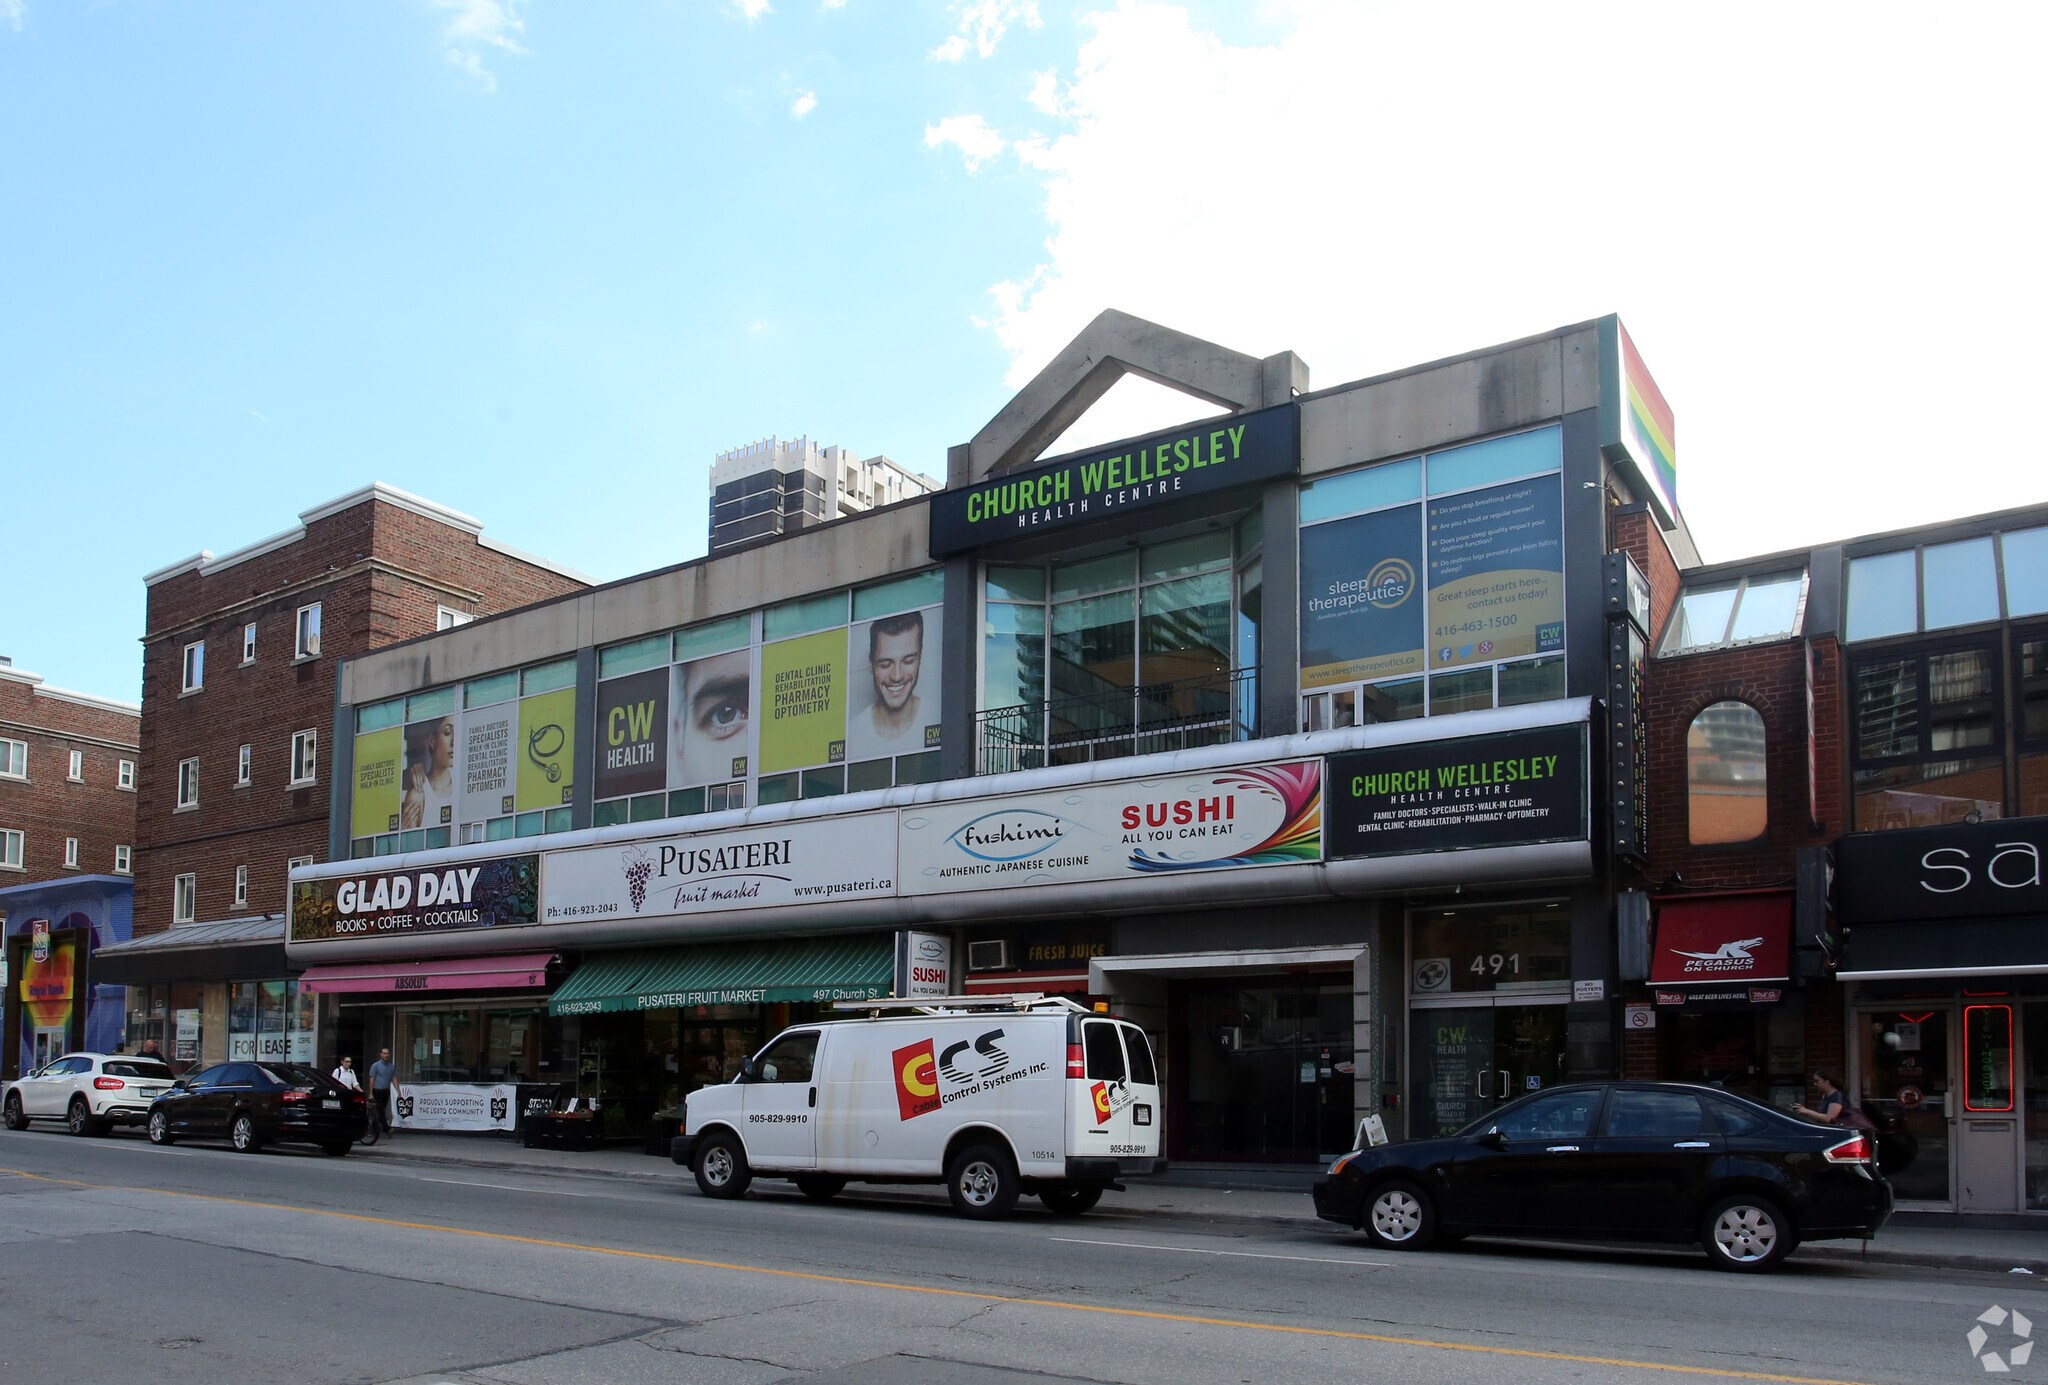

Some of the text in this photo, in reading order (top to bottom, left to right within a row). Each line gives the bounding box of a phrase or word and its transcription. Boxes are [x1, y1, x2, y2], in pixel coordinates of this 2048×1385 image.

[968, 424, 1246, 523] CHURCH WELLESLEY
[1018, 476, 1182, 527] HEALTH CENTRE
[1475, 496, 1504, 507] breathing
[1513, 490, 1532, 500] night?
[1490, 510, 1511, 520] regular
[1512, 505, 1534, 514] snorer?
[1471, 530, 1486, 539] sleep
[1488, 526, 1508, 536] quality
[1509, 522, 1530, 530] impact
[1441, 538, 1492, 552] daytime function?
[1450, 555, 1471, 564] restless
[1486, 548, 1509, 557] prevent
[1441, 565, 1462, 574] asleep?
[1329, 580, 1368, 595] sleep
[1438, 577, 1548, 602] Great sleep starts here...
[1309, 586, 1404, 612] therapeutics
[1468, 598, 1502, 609] contact
[1518, 588, 1548, 598] today!
[1436, 614, 1518, 637] 416-463-1500
[1540, 627, 1560, 639] CW
[776, 663, 831, 683] DENTAL CLINIC
[1309, 656, 1415, 679] www.sleeptherapeutics.ca
[775, 675, 830, 693] REHABILITATION
[775, 685, 830, 706] PHARMACY
[775, 699, 830, 719] OPTOMETRY
[469, 720, 508, 734] FAMILY DOCTORS
[607, 700, 655, 746] CW
[469, 728, 508, 745] SPECIALISTS
[927, 728, 940, 739] CW
[469, 739, 507, 753] WALK-IN CLINIC
[831, 744, 843, 754] CW
[468, 748, 507, 762] DENTAL CLINIC
[607, 743, 654, 770] HEALTH
[376, 760, 394, 769] DOCTORS
[468, 757, 507, 771] REHABILITATION
[734, 760, 745, 769] CW
[360, 767, 394, 781] SPECIALISTS
[468, 766, 506, 782] PHARMACY
[1352, 755, 1558, 797] CHURCH WELLESLEY
[360, 777, 394, 789] WALK-IN CLINIC
[467, 778, 506, 793] OPTOMETRY
[564, 788, 573, 797] CW
[1391, 784, 1510, 804] HEALTH CENTRE
[503, 798, 513, 807] CW
[1374, 798, 1532, 820] FAMILY DOCTORS SPECIALISTS WALK-IN CLINIC
[442, 808, 450, 817] CW
[1121, 795, 1235, 830] SUSHI
[1358, 808, 1549, 832] DENTAL CLINIC REHABILITATION PHARMACY OPTOMETRY
[964, 819, 1063, 846] fushimi
[1122, 824, 1233, 844] ALL YOU CAN EAT
[658, 839, 791, 877] PUSATERI
[939, 855, 1090, 878] AUTHENTIC JAPANESE CUISINE
[337, 867, 481, 914] GLAD DAY
[794, 878, 892, 896] www.pusateri.ca
[674, 882, 761, 909] fruit market
[547, 903, 618, 917] Ph: 416-923-2043
[336, 908, 479, 933] BOOKS COFFEE COCKTAILS
[34, 950, 46, 958] RBC
[1029, 944, 1104, 960] FRESH JUICE
[1470, 953, 1520, 975] 491
[1686, 958, 1755, 966] PEGASUS
[394, 976, 428, 990] ABSOLUT.
[913, 967, 945, 984] SUSHI
[29, 982, 64, 996] Royal Bank
[813, 988, 880, 1000] 497 Church St.
[638, 989, 767, 1007] PUSATERI FRUIT MARKET
[557, 1001, 602, 1014] 416-923-2043
[1437, 1027, 1466, 1044] CW
[234, 1039, 292, 1054] FOR LEASE
[1437, 1046, 1466, 1054] HEALTH
[902, 1028, 1009, 1097] CCS
[913, 1062, 1049, 1114] Cable Control Systems Inc.
[1437, 1102, 1466, 1110] CHURCH
[749, 1114, 807, 1125] 905-829-9910
[1032, 1150, 1055, 1159] 10514
[1110, 1145, 1146, 1154] 905-829-9910
